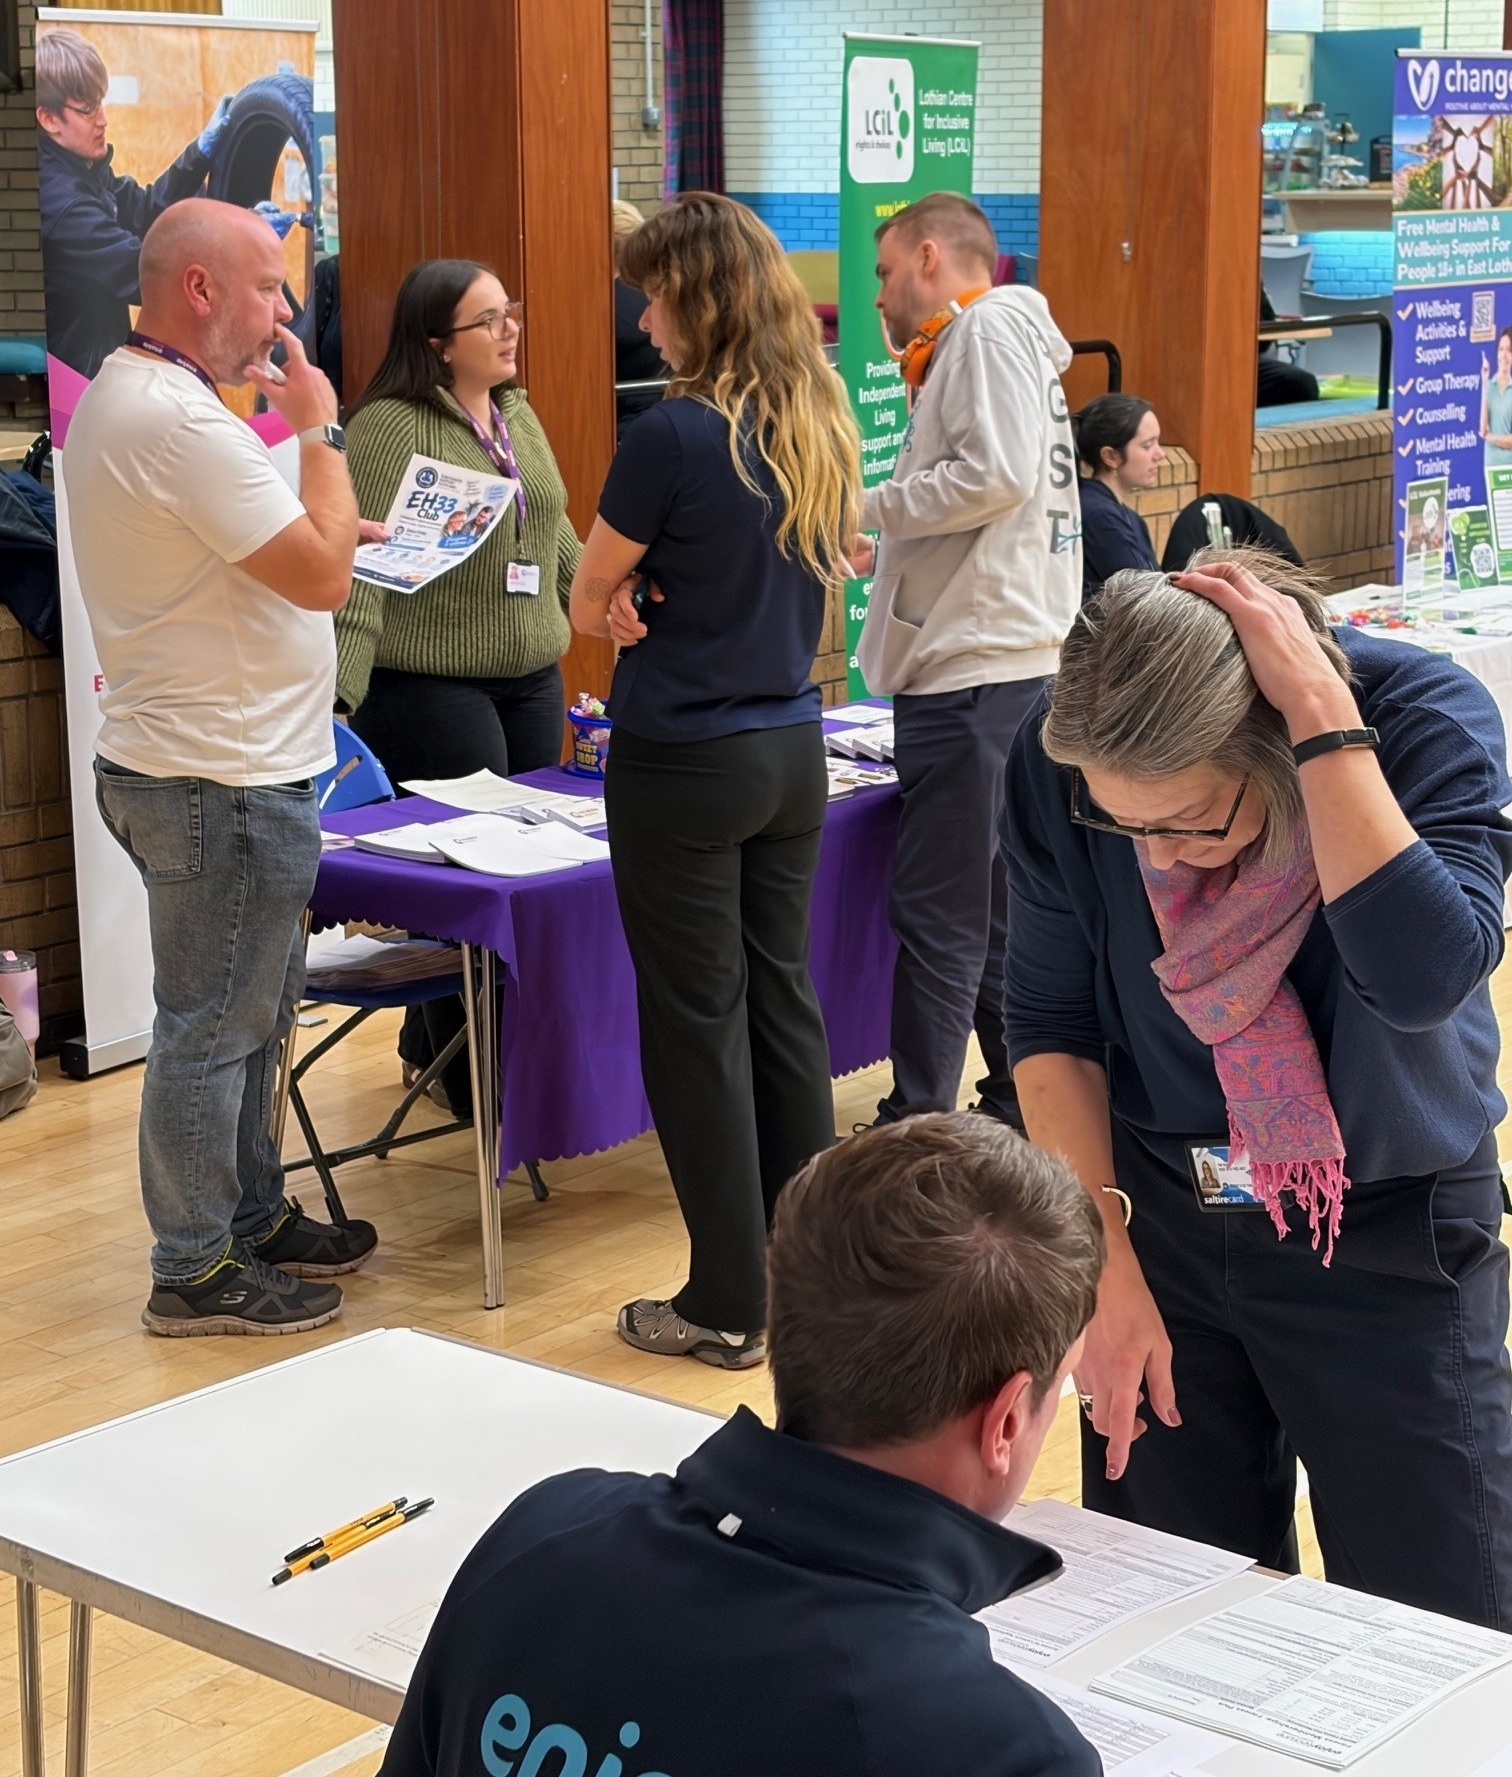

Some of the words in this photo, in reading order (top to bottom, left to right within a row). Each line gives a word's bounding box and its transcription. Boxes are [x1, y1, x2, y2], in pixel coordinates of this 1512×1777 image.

[1444, 59, 1512, 101] chang
[918, 89, 948, 106] Lothian
[949, 90, 973, 106] Centre
[865, 109, 894, 136] LCiL
[922, 113, 935, 129] for
[936, 114, 970, 129] Inclusive
[922, 137, 946, 157] Living
[1397, 219, 1425, 236] Free
[1425, 218, 1457, 235] Mental
[1458, 216, 1490, 233] Health
[1491, 215, 1501, 232] &
[1397, 239, 1450, 259] Wellbeing
[1451, 238, 1490, 258] Support
[1492, 236, 1512, 253] For
[1397, 262, 1437, 282] People
[1455, 260, 1466, 276] in
[1467, 259, 1487, 275] East
[1415, 299, 1462, 319] Wellbeing
[1415, 321, 1458, 342] Activities
[1458, 320, 1467, 338] &
[1415, 345, 1451, 366] Support
[866, 359, 901, 379] Providing
[859, 383, 906, 405] Independent
[1416, 377, 1443, 395] Group
[1443, 373, 1480, 391] Therapy
[874, 408, 896, 427] Living
[1416, 403, 1467, 425] Counselling
[861, 432, 892, 454] support
[1416, 434, 1446, 455] Mental
[1446, 430, 1477, 451] Health
[1415, 457, 1451, 476] Training
[406, 490, 458, 514] EH33
[1448, 484, 1471, 503] ering
[417, 508, 440, 521] Club
[1204, 1194, 1244, 1205] saltirecard
